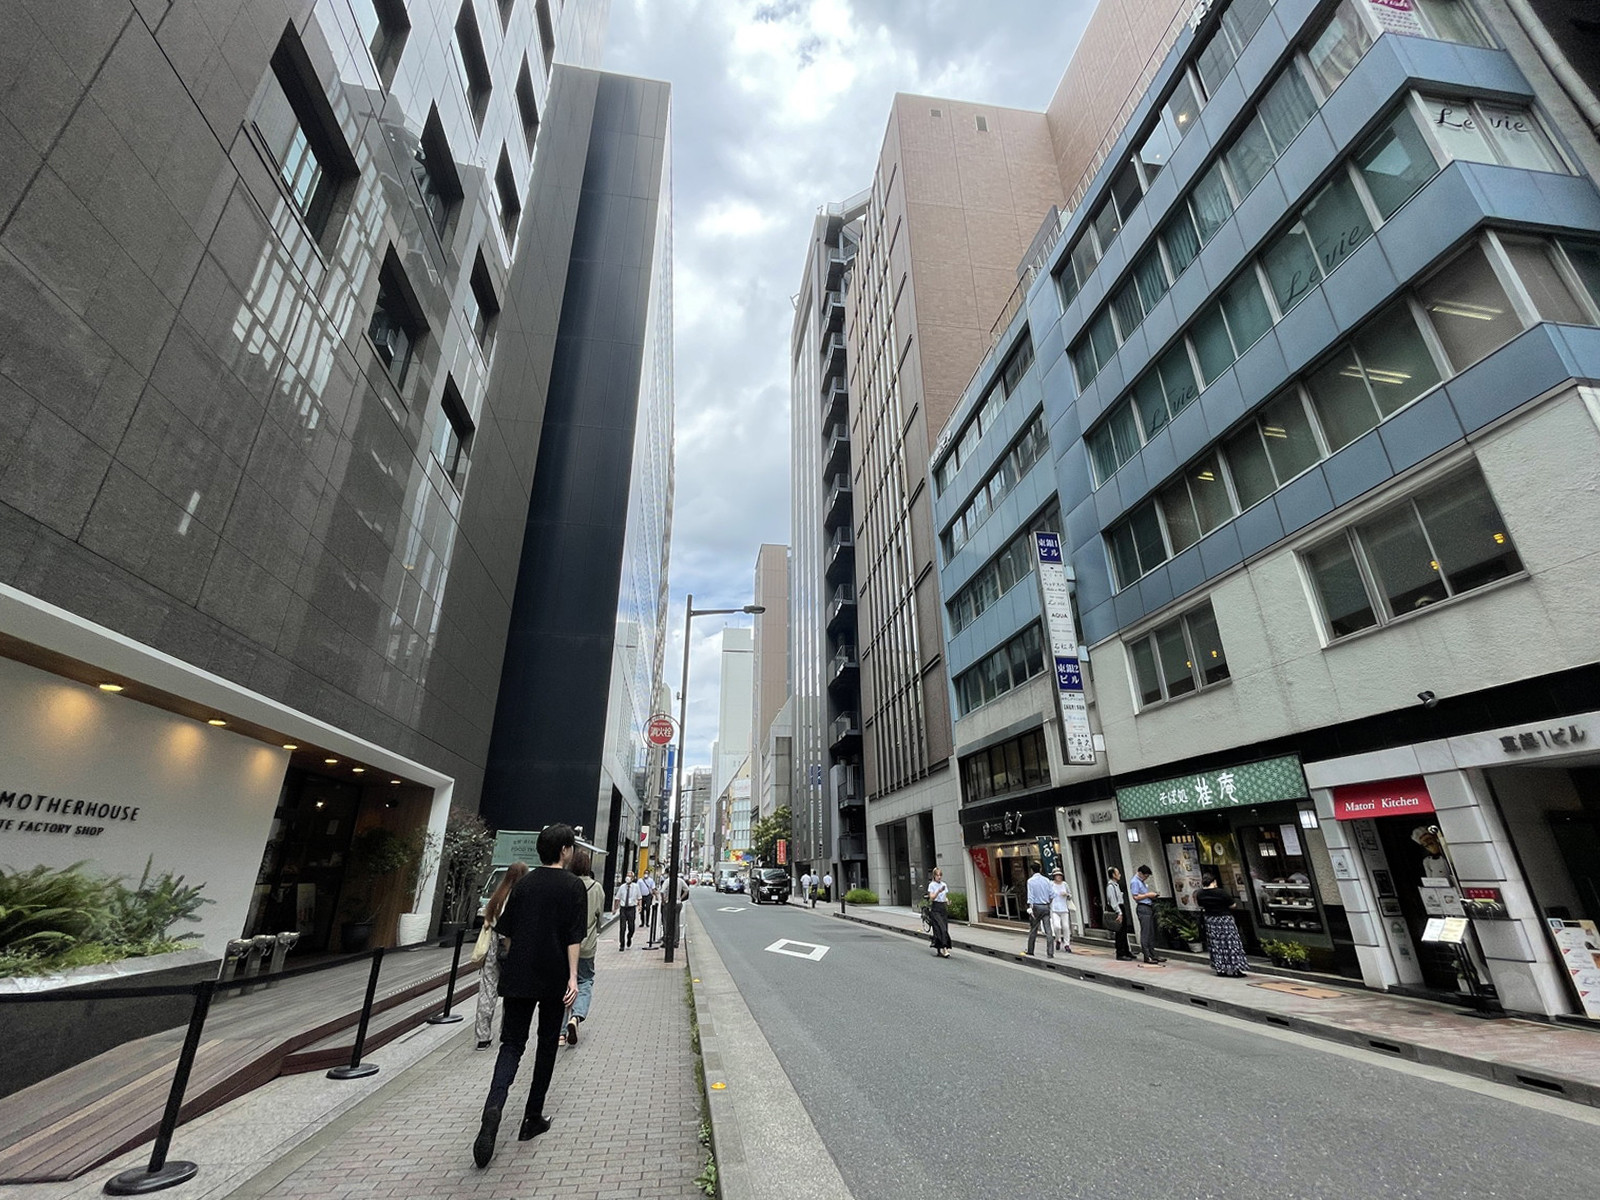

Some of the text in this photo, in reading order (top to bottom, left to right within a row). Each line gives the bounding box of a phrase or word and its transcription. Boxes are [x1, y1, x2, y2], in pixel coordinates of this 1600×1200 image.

[1490, 115, 1534, 132] vie
[1326, 226, 1367, 267] vie
[1173, 386, 1197, 411] vie
[1040, 548, 1059, 557] ビル
[1060, 674, 1080, 684] ビル
[1159, 771, 1239, 808] そば処 桂庵
[0, 790, 140, 821] MOTHERHOUSE
[1345, 797, 1419, 812] Matori Kitchen
[18, 820, 73, 834] FACTORY
[75, 825, 104, 836] SHOP
